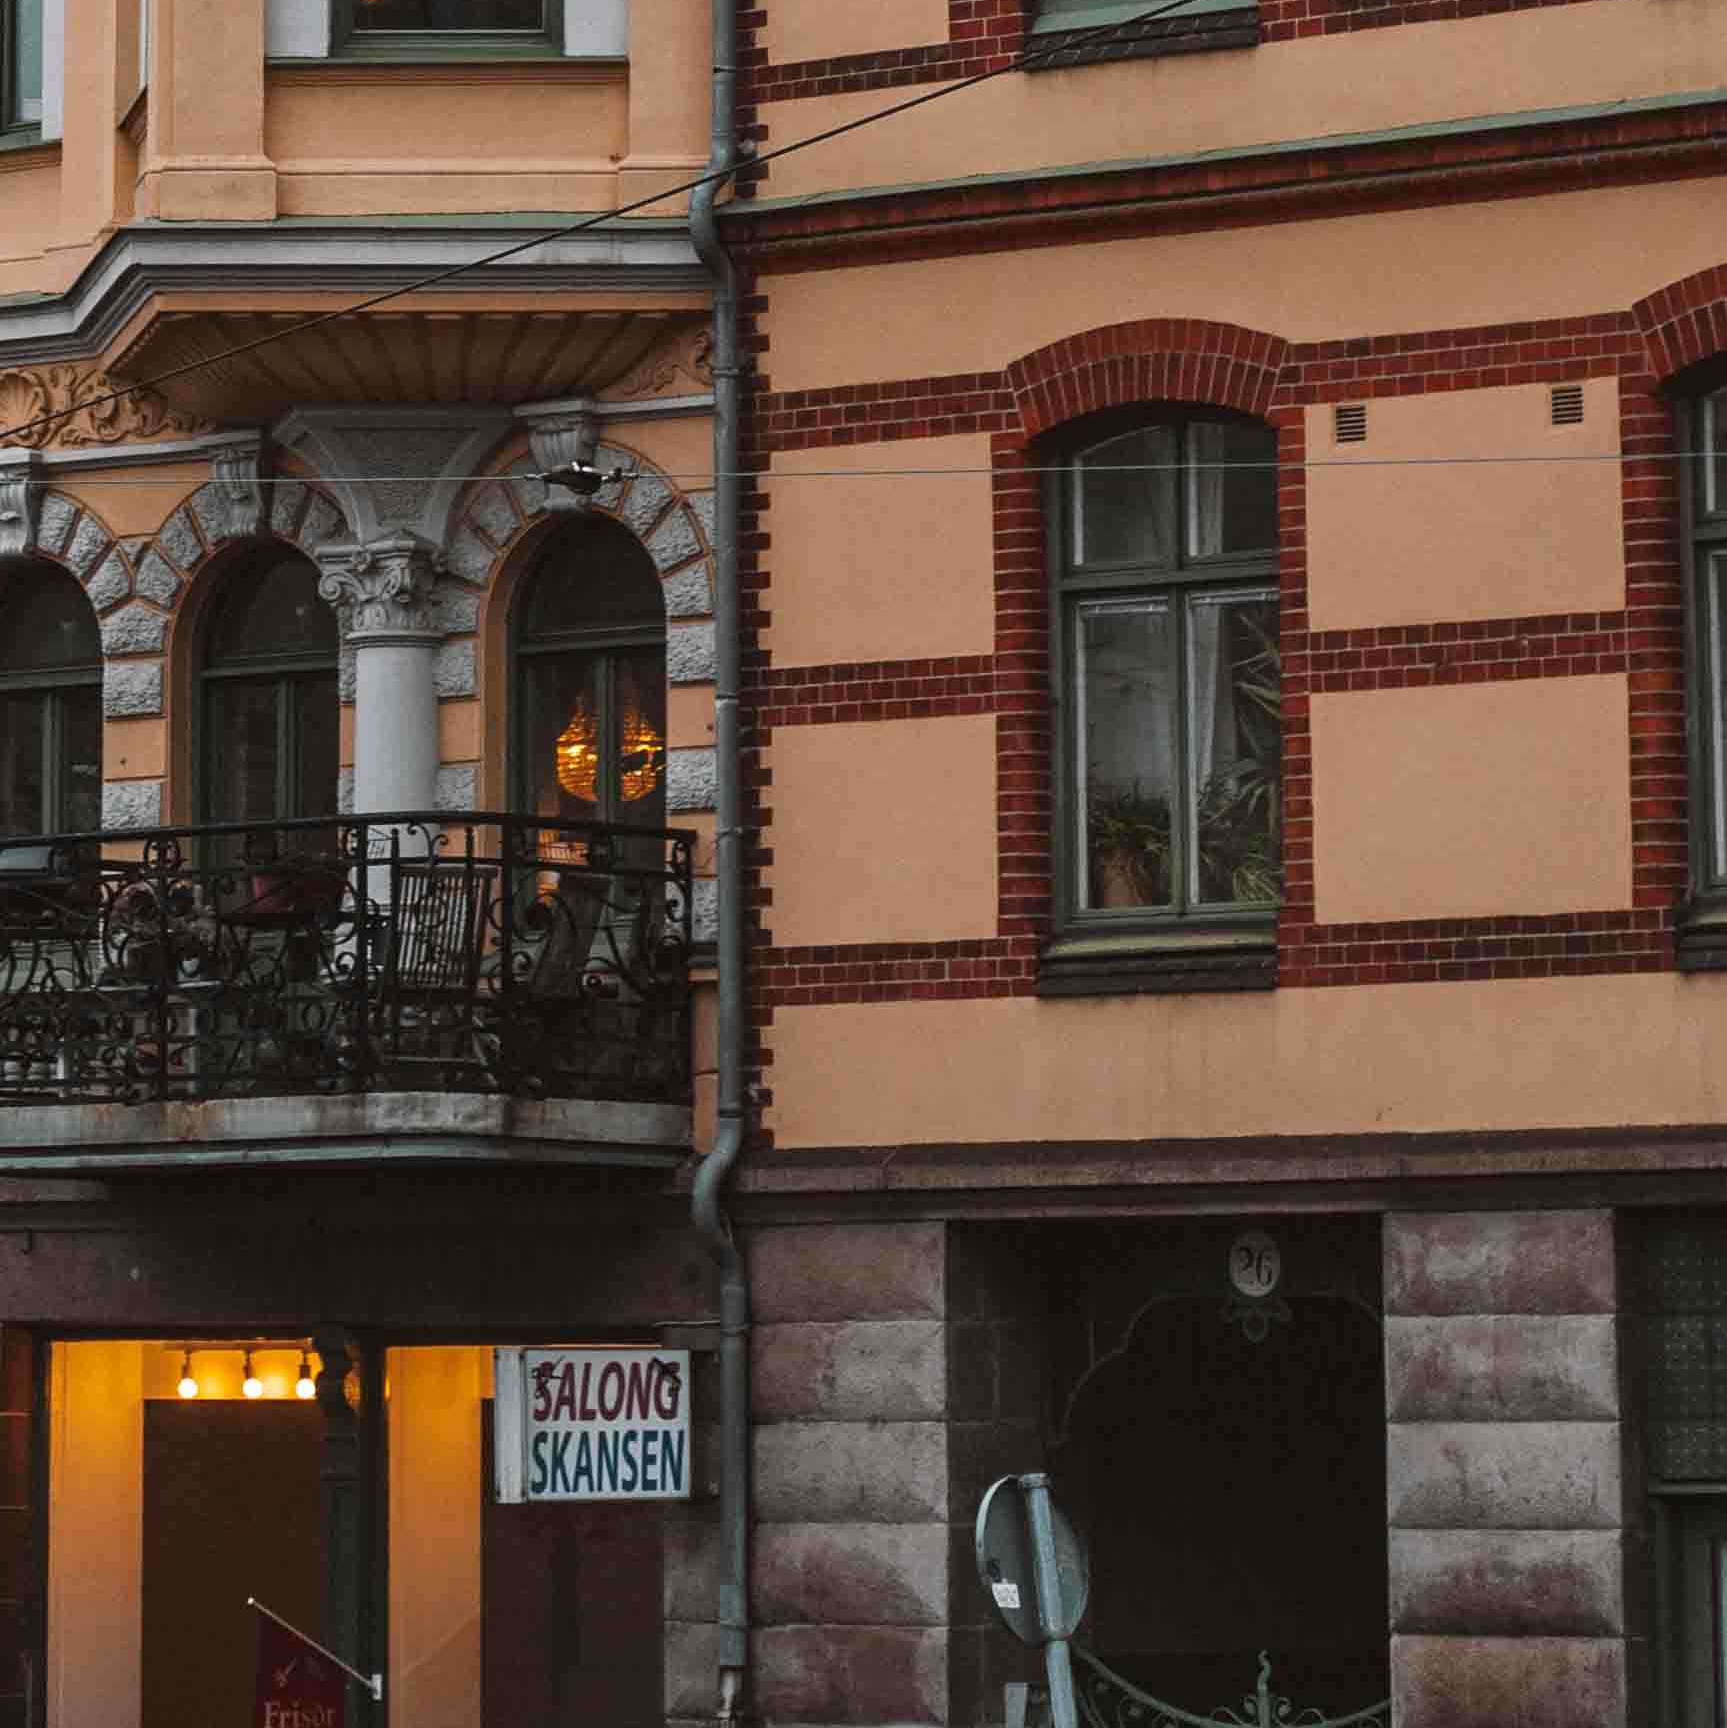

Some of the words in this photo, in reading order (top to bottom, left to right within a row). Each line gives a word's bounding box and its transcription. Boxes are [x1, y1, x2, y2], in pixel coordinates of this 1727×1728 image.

[1239, 1246, 1273, 1286] 26
[532, 1361, 681, 1421] SALONG
[531, 1430, 684, 1493] SKANSEN
